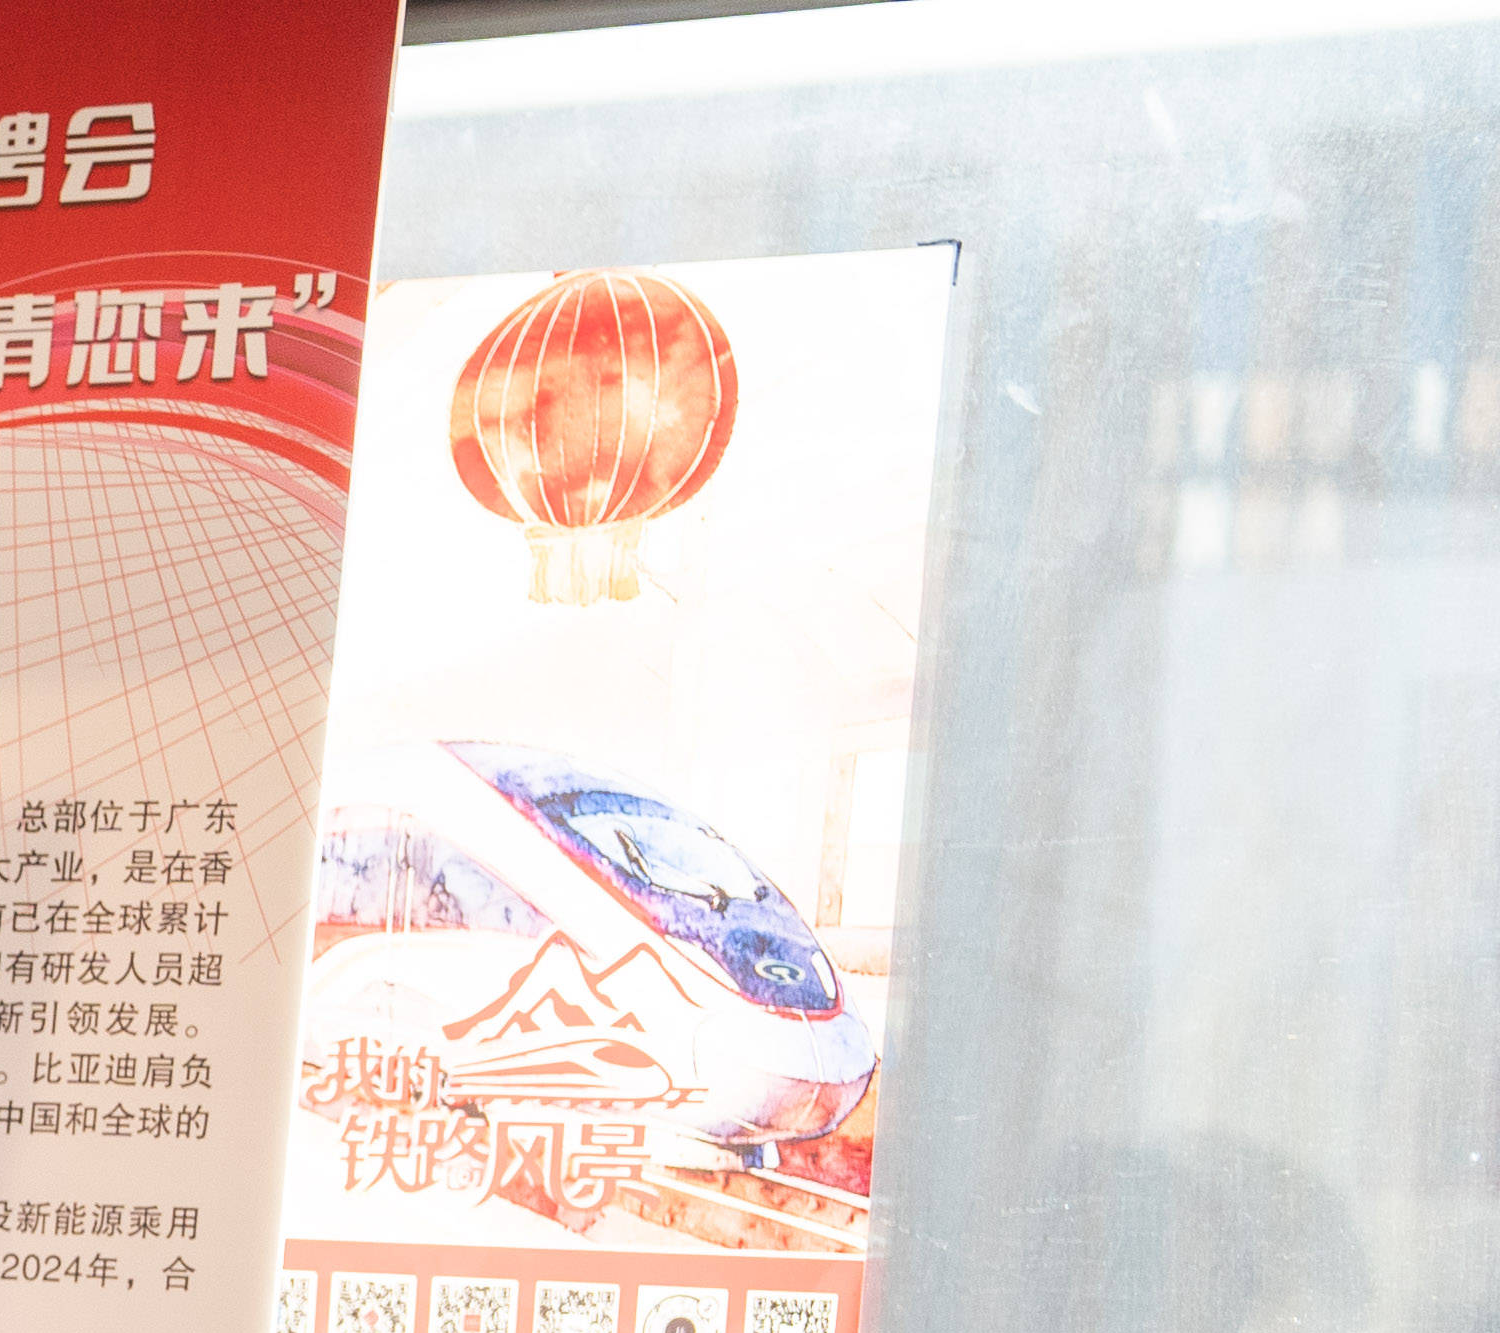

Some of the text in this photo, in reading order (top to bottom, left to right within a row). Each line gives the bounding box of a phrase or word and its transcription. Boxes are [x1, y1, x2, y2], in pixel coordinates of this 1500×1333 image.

[304, 1036, 443, 1108] 我的
[341, 1116, 660, 1209] 铁路风景
